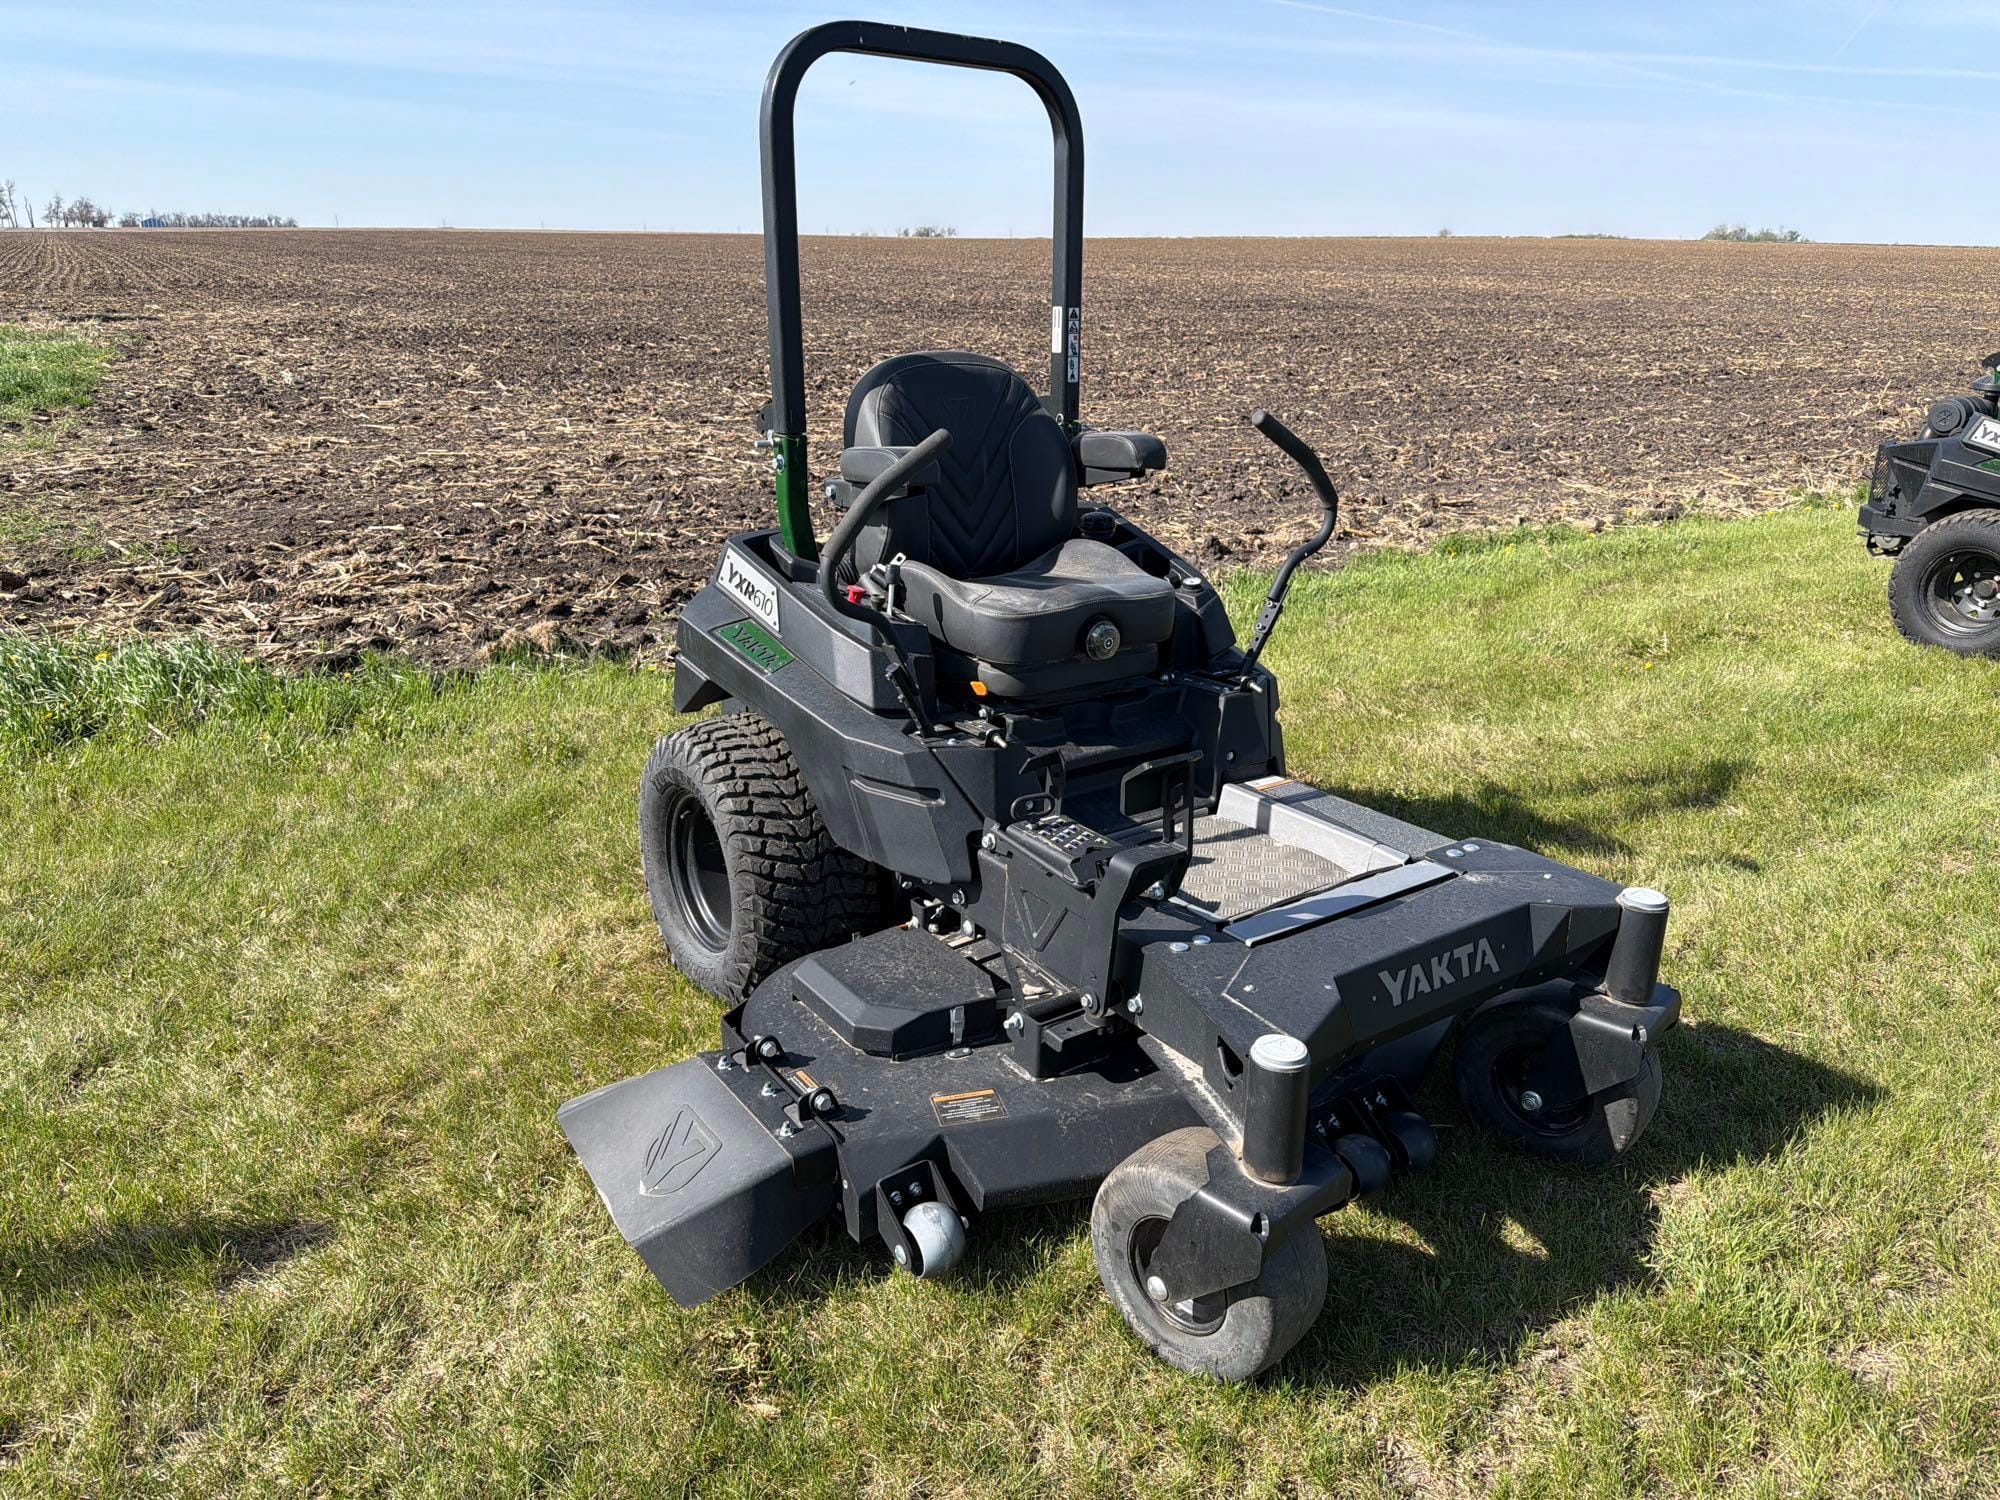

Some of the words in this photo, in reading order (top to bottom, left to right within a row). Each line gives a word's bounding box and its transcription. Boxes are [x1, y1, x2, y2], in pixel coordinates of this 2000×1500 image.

[1982, 426, 2000, 445] YX
[728, 562, 774, 617] YXR610
[1378, 938, 1501, 1006] YAKTA
